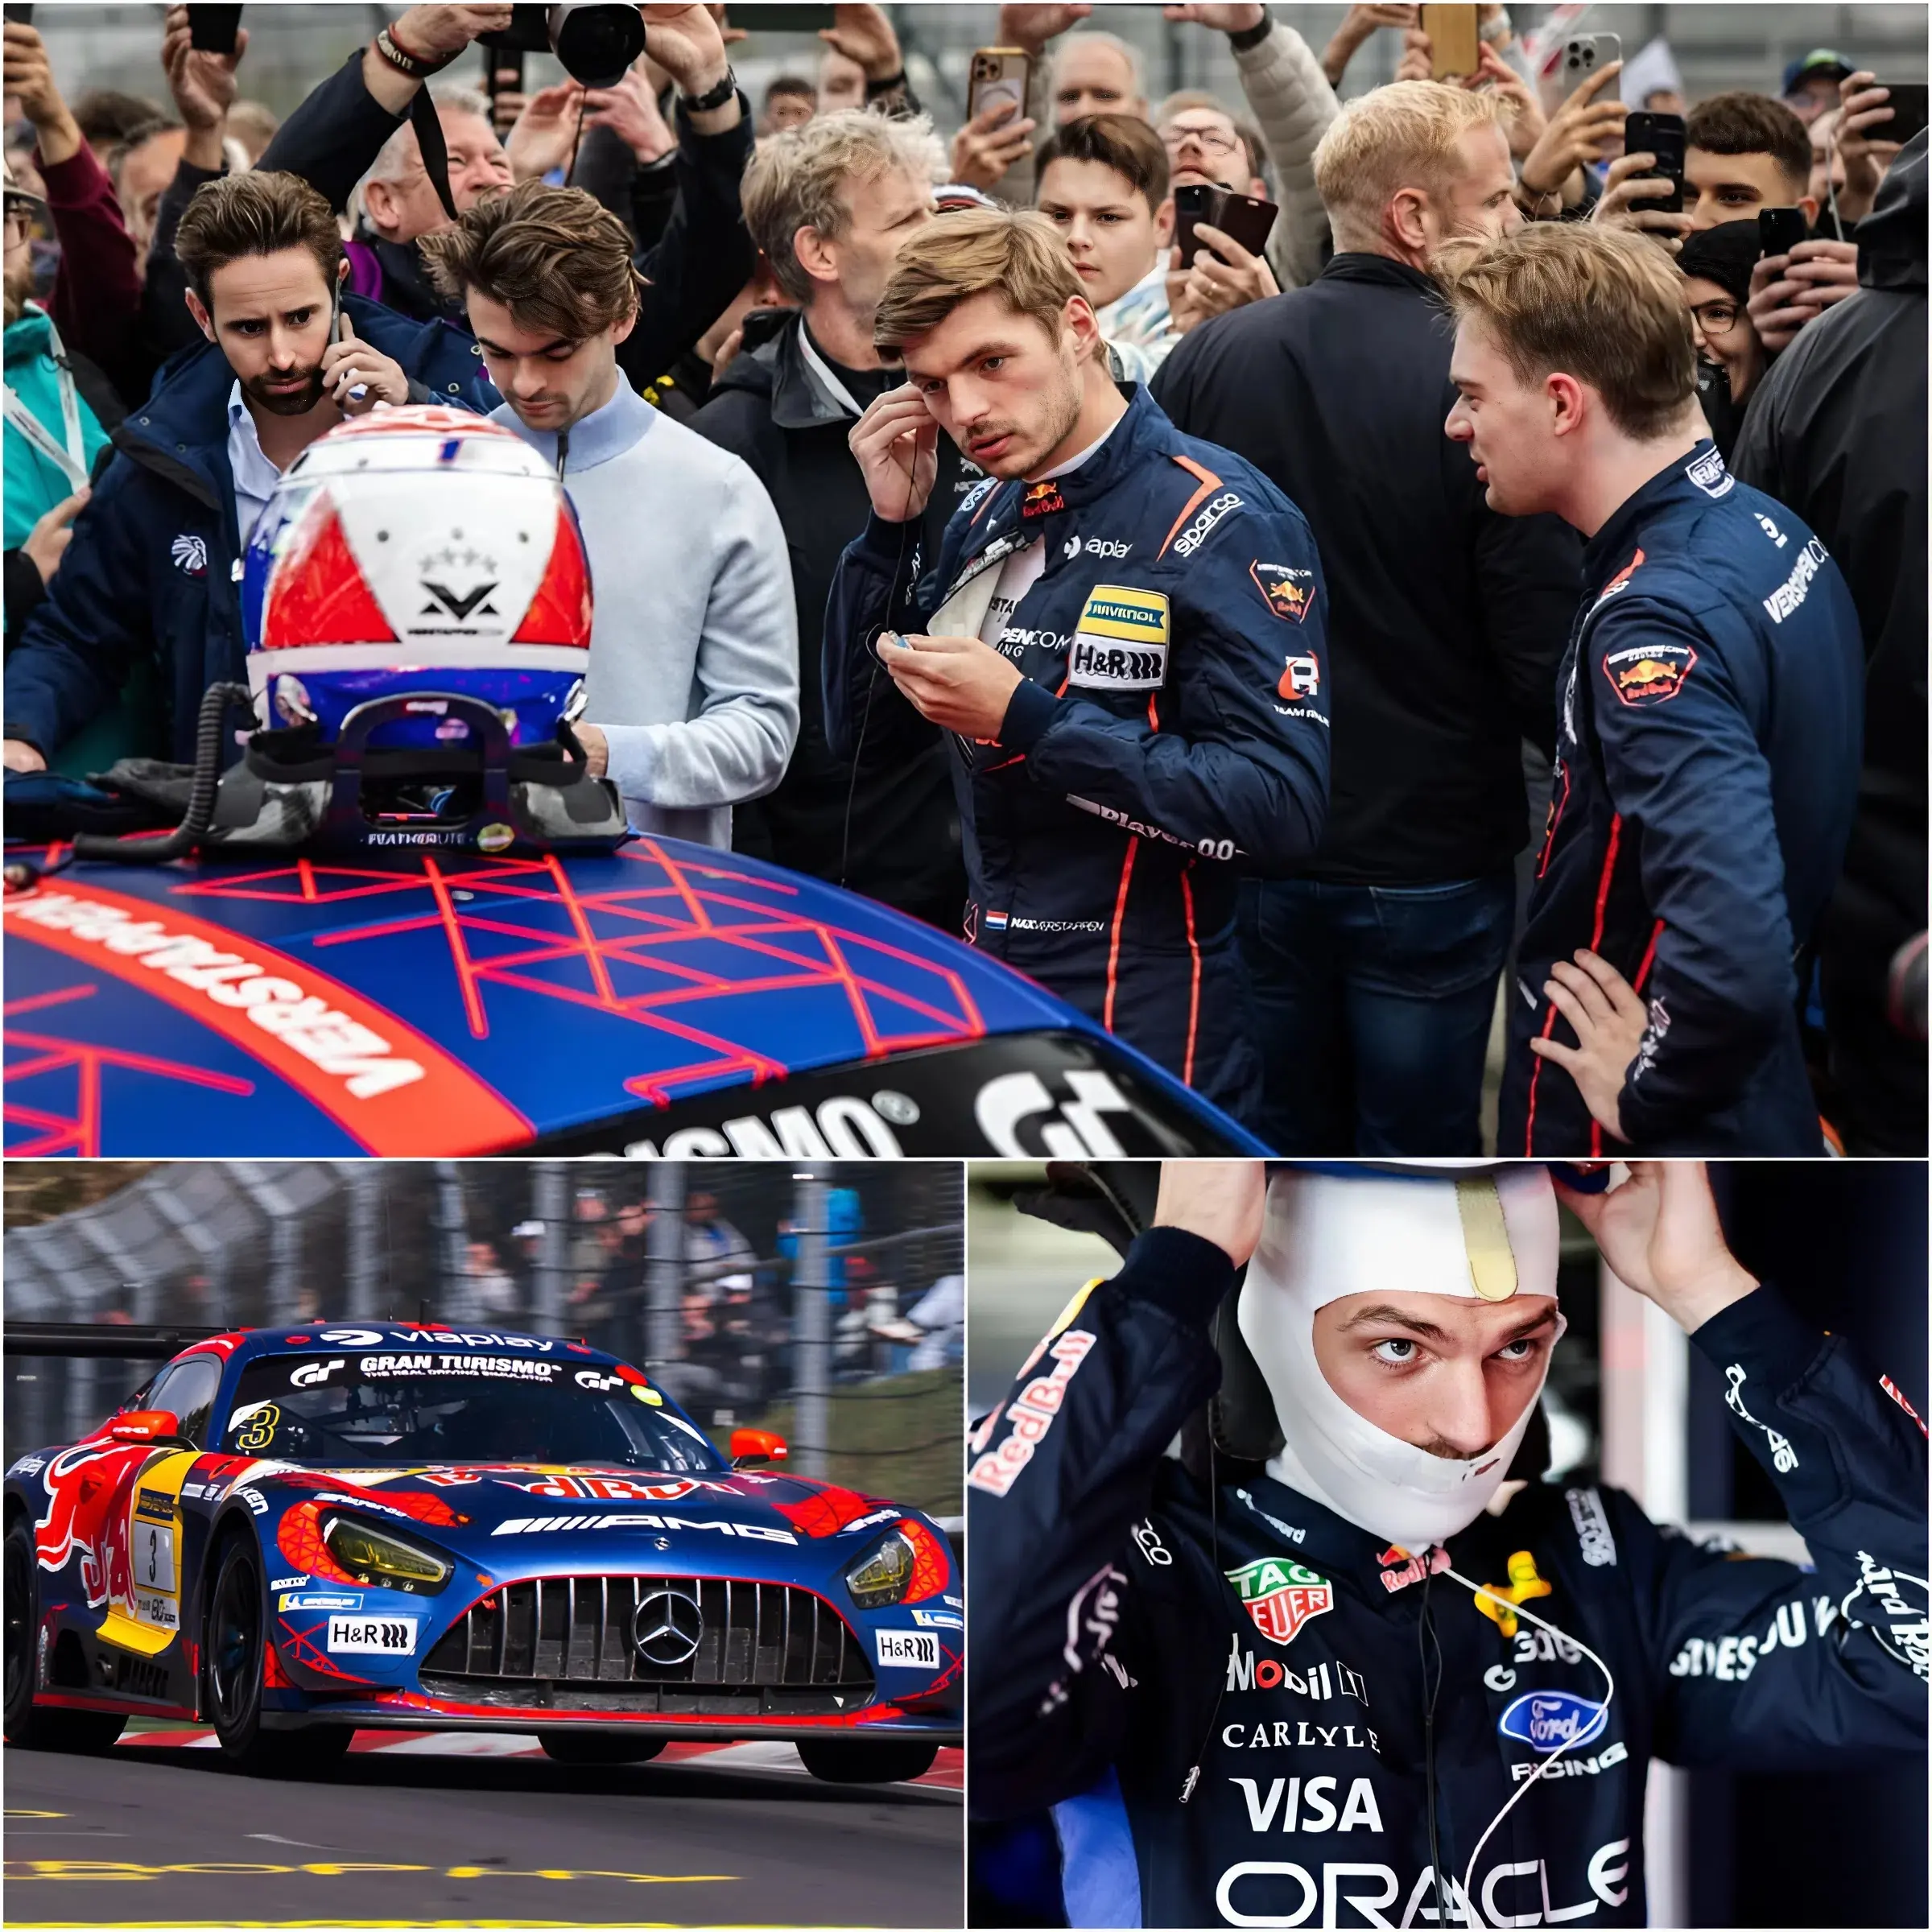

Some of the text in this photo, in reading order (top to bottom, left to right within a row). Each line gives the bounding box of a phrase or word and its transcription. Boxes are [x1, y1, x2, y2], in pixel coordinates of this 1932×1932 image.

[1174, 493, 1244, 556] sparco
[1074, 642, 1128, 679] H&R
[16, 891, 425, 1099] VERSTAPPEN
[390, 1330, 554, 1352] viaplay
[360, 1355, 431, 1372] GRAN
[239, 1404, 280, 1449] 3
[600, 1515, 799, 1546] AMG
[149, 1530, 157, 1583] 3
[1234, 1563, 1321, 1598] TAG
[333, 1623, 378, 1645] H&R
[1253, 1590, 1327, 1638] EUER
[881, 1637, 914, 1658] H&R
[1227, 1650, 1332, 1700] Mobil
[1222, 1721, 1381, 1754] CARLYLE
[1228, 1776, 1384, 1833] VISA
[1216, 1836, 1630, 1929] ORACLE
